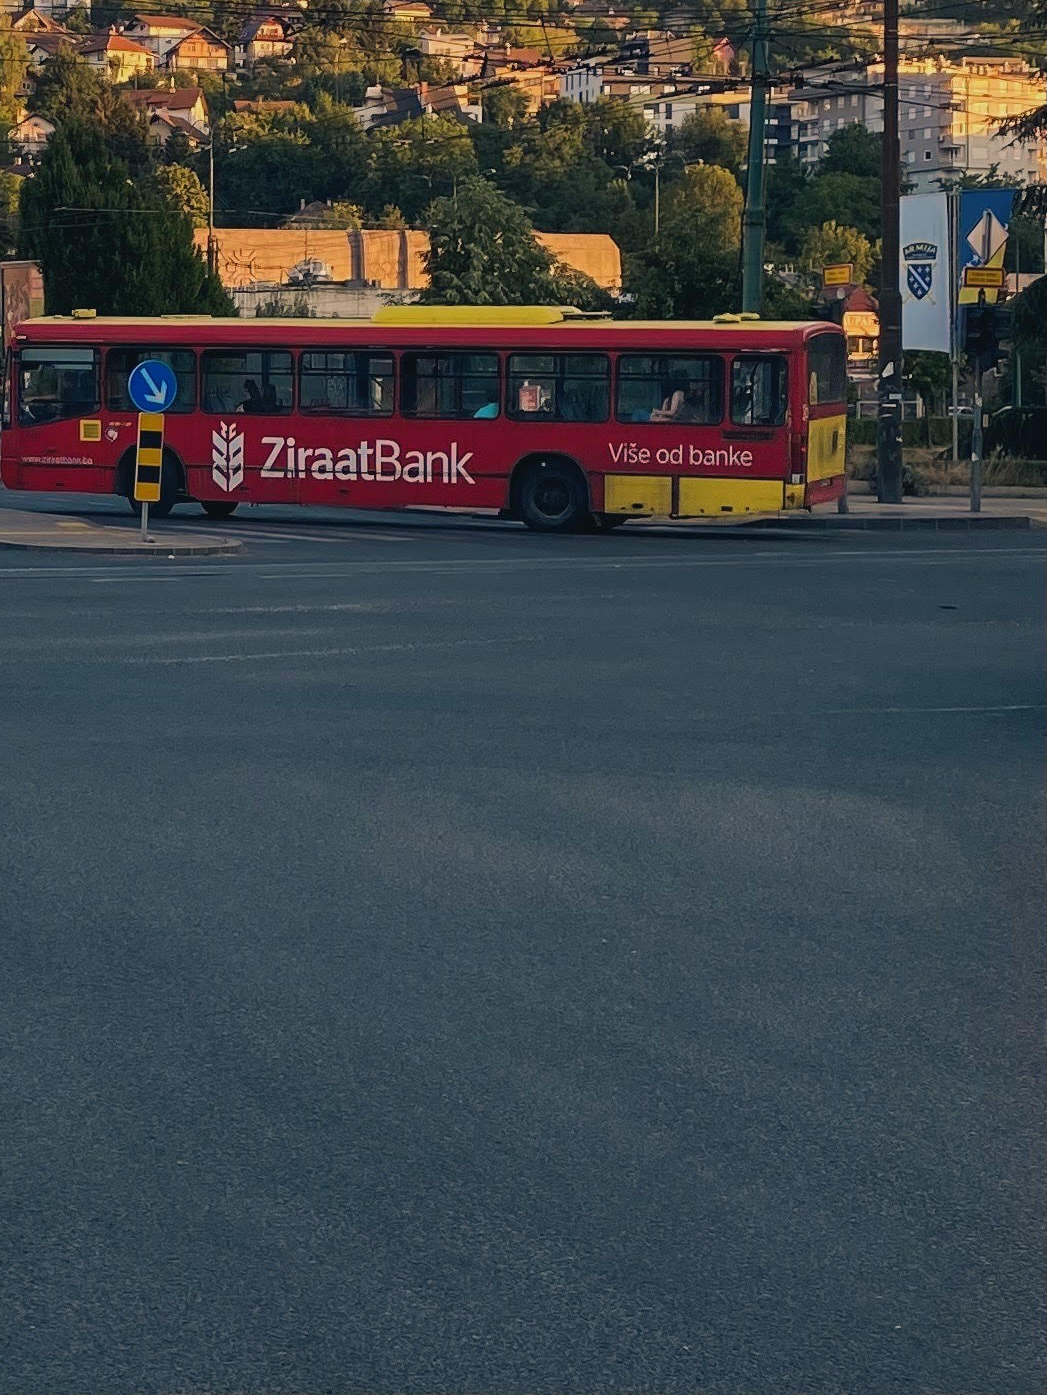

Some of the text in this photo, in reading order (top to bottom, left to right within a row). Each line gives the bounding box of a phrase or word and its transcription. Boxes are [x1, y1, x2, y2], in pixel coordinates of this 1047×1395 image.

[260, 437, 476, 484] ZiraatBank
[608, 443, 753, 467] Više od banke
